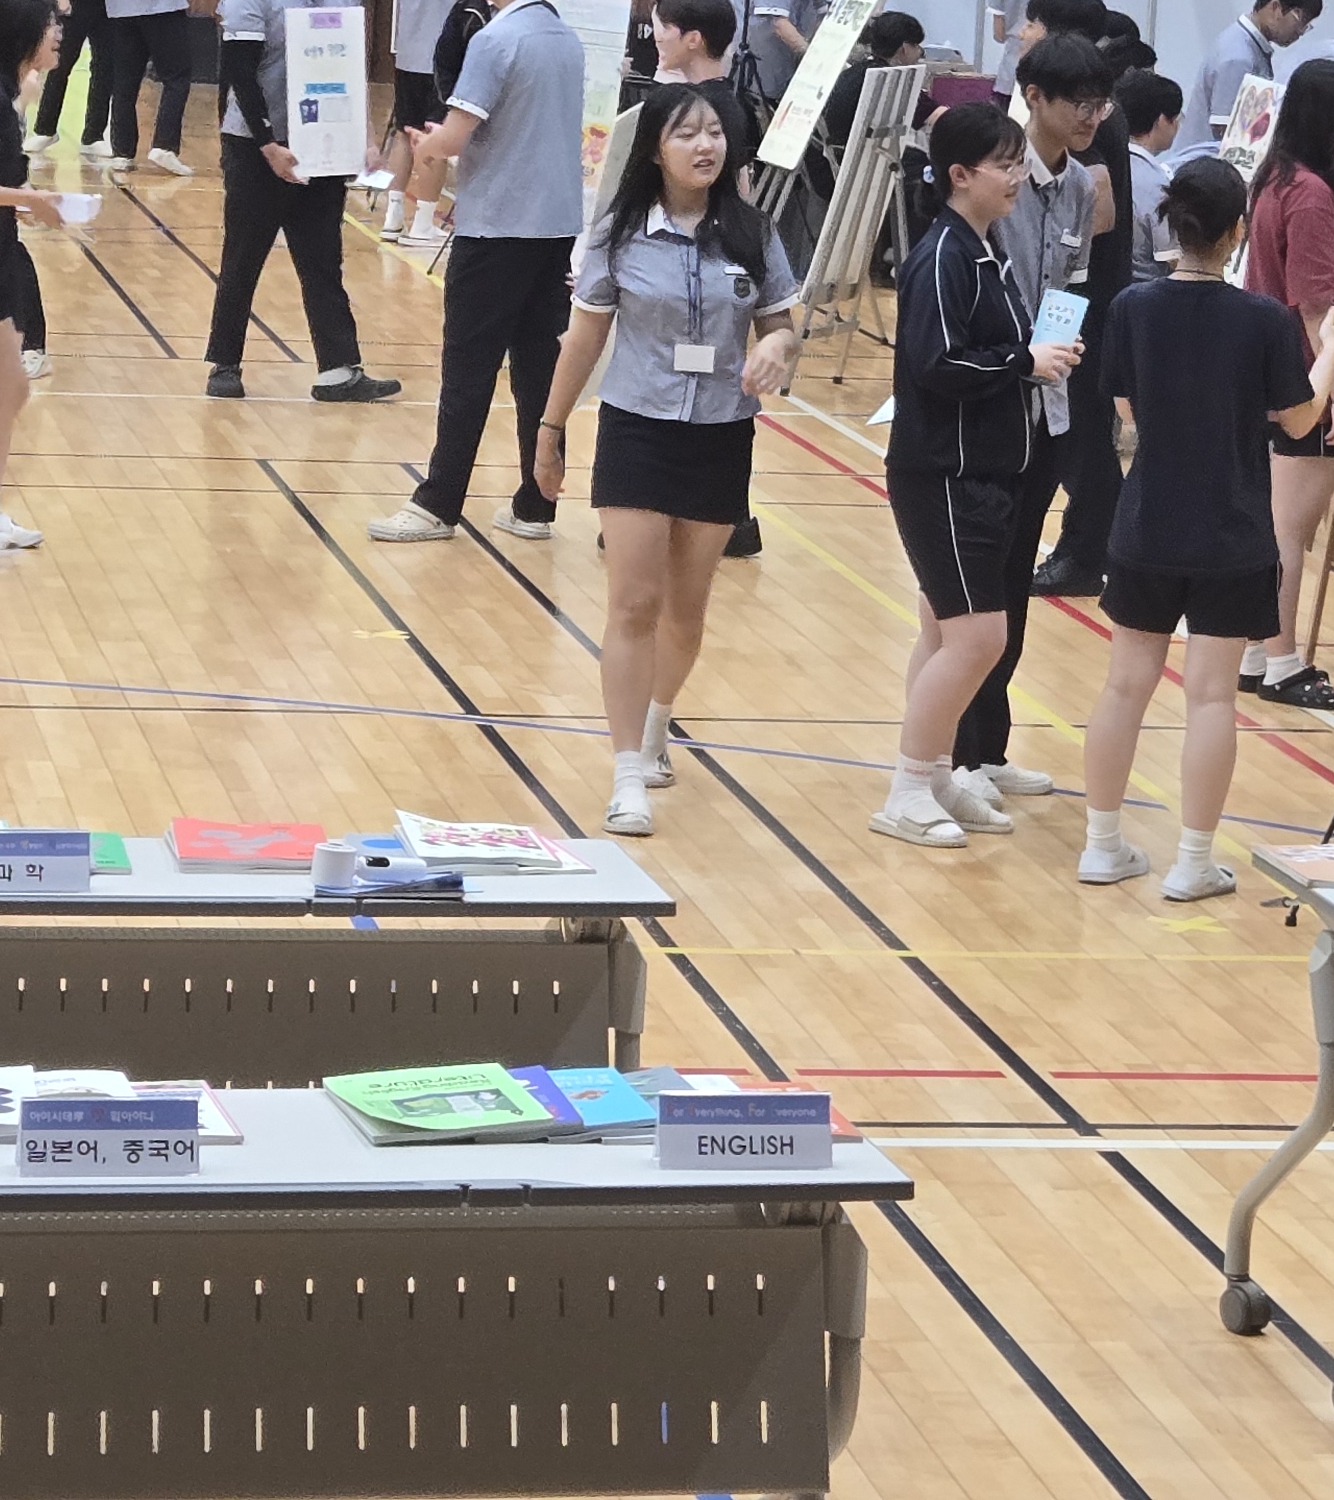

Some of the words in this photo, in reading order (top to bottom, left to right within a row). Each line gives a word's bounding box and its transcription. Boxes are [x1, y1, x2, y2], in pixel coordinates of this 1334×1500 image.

[768, 1103, 817, 1118] veryone
[25, 1138, 107, 1165] 일본어,
[122, 1138, 196, 1164] 중국어
[697, 1134, 795, 1156] ENGLISH
